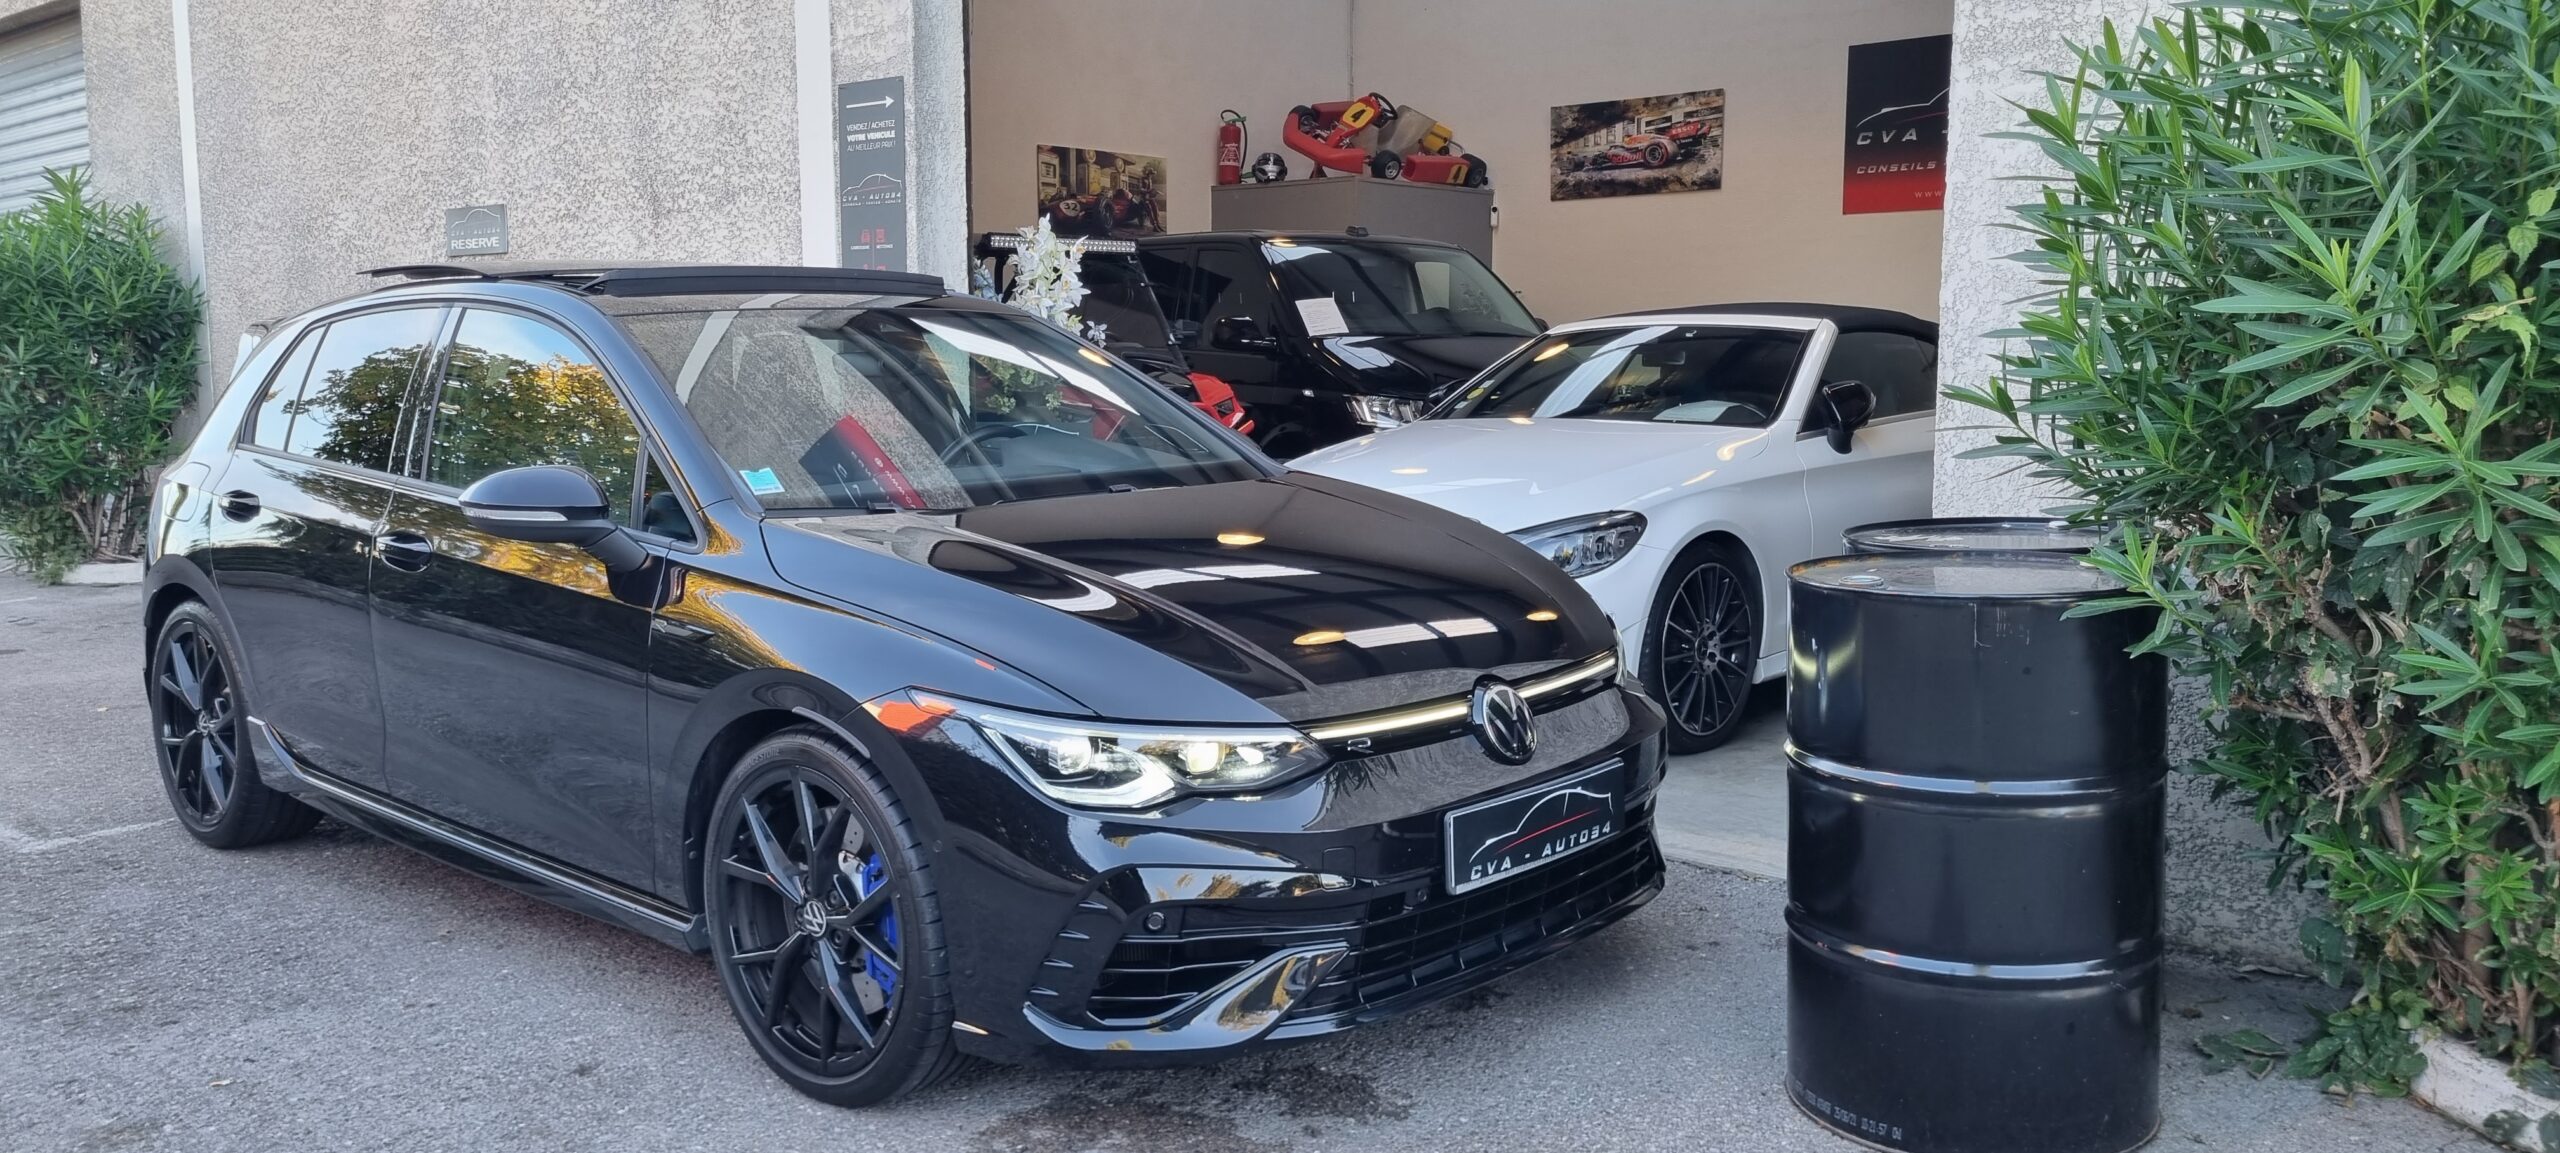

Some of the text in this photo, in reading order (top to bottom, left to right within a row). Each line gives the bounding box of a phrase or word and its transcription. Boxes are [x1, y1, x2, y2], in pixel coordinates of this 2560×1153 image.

[1350, 108, 1367, 123] 4
[846, 133, 866, 142] VOTRE
[1856, 127, 1918, 146] CVA
[855, 141, 881, 151] MEILLEUR
[1452, 165, 1462, 183] 4
[1856, 161, 1937, 174] CONSEILS
[1063, 202, 1079, 212] 32
[450, 236, 500, 250] RESERVE
[1470, 855, 1512, 881] CVA
[1541, 820, 1611, 857] AUTO34
